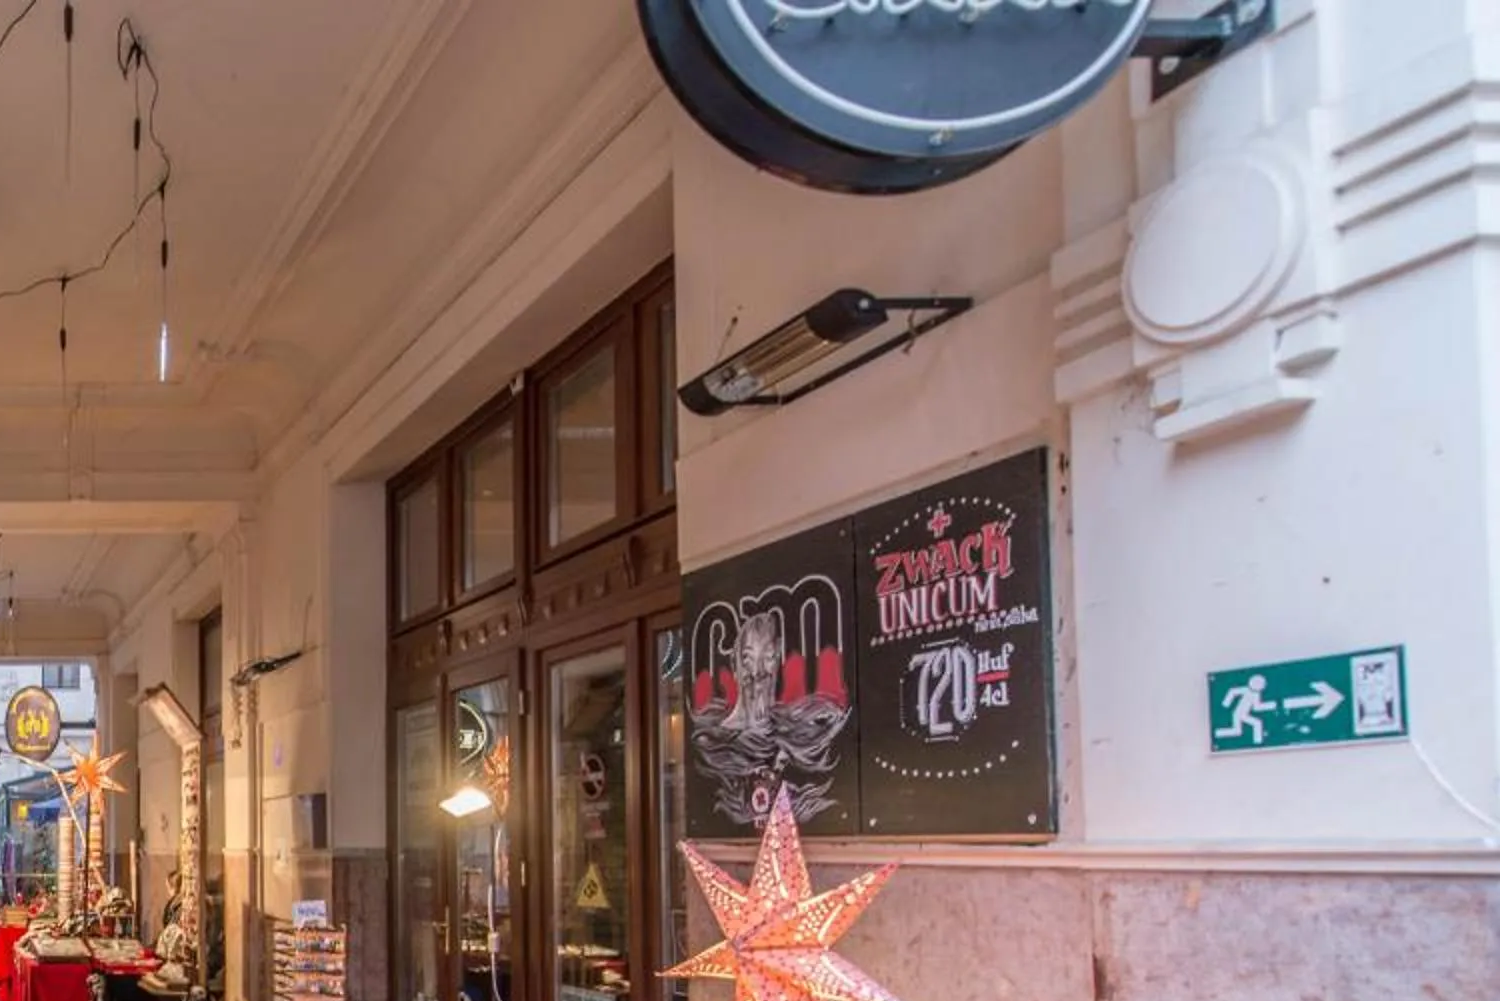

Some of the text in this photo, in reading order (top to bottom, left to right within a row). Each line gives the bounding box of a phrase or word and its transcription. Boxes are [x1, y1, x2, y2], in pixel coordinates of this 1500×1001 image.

[875, 520, 1015, 597] ZWACK
[878, 571, 998, 635] UNICUM
[908, 645, 977, 736] 720
